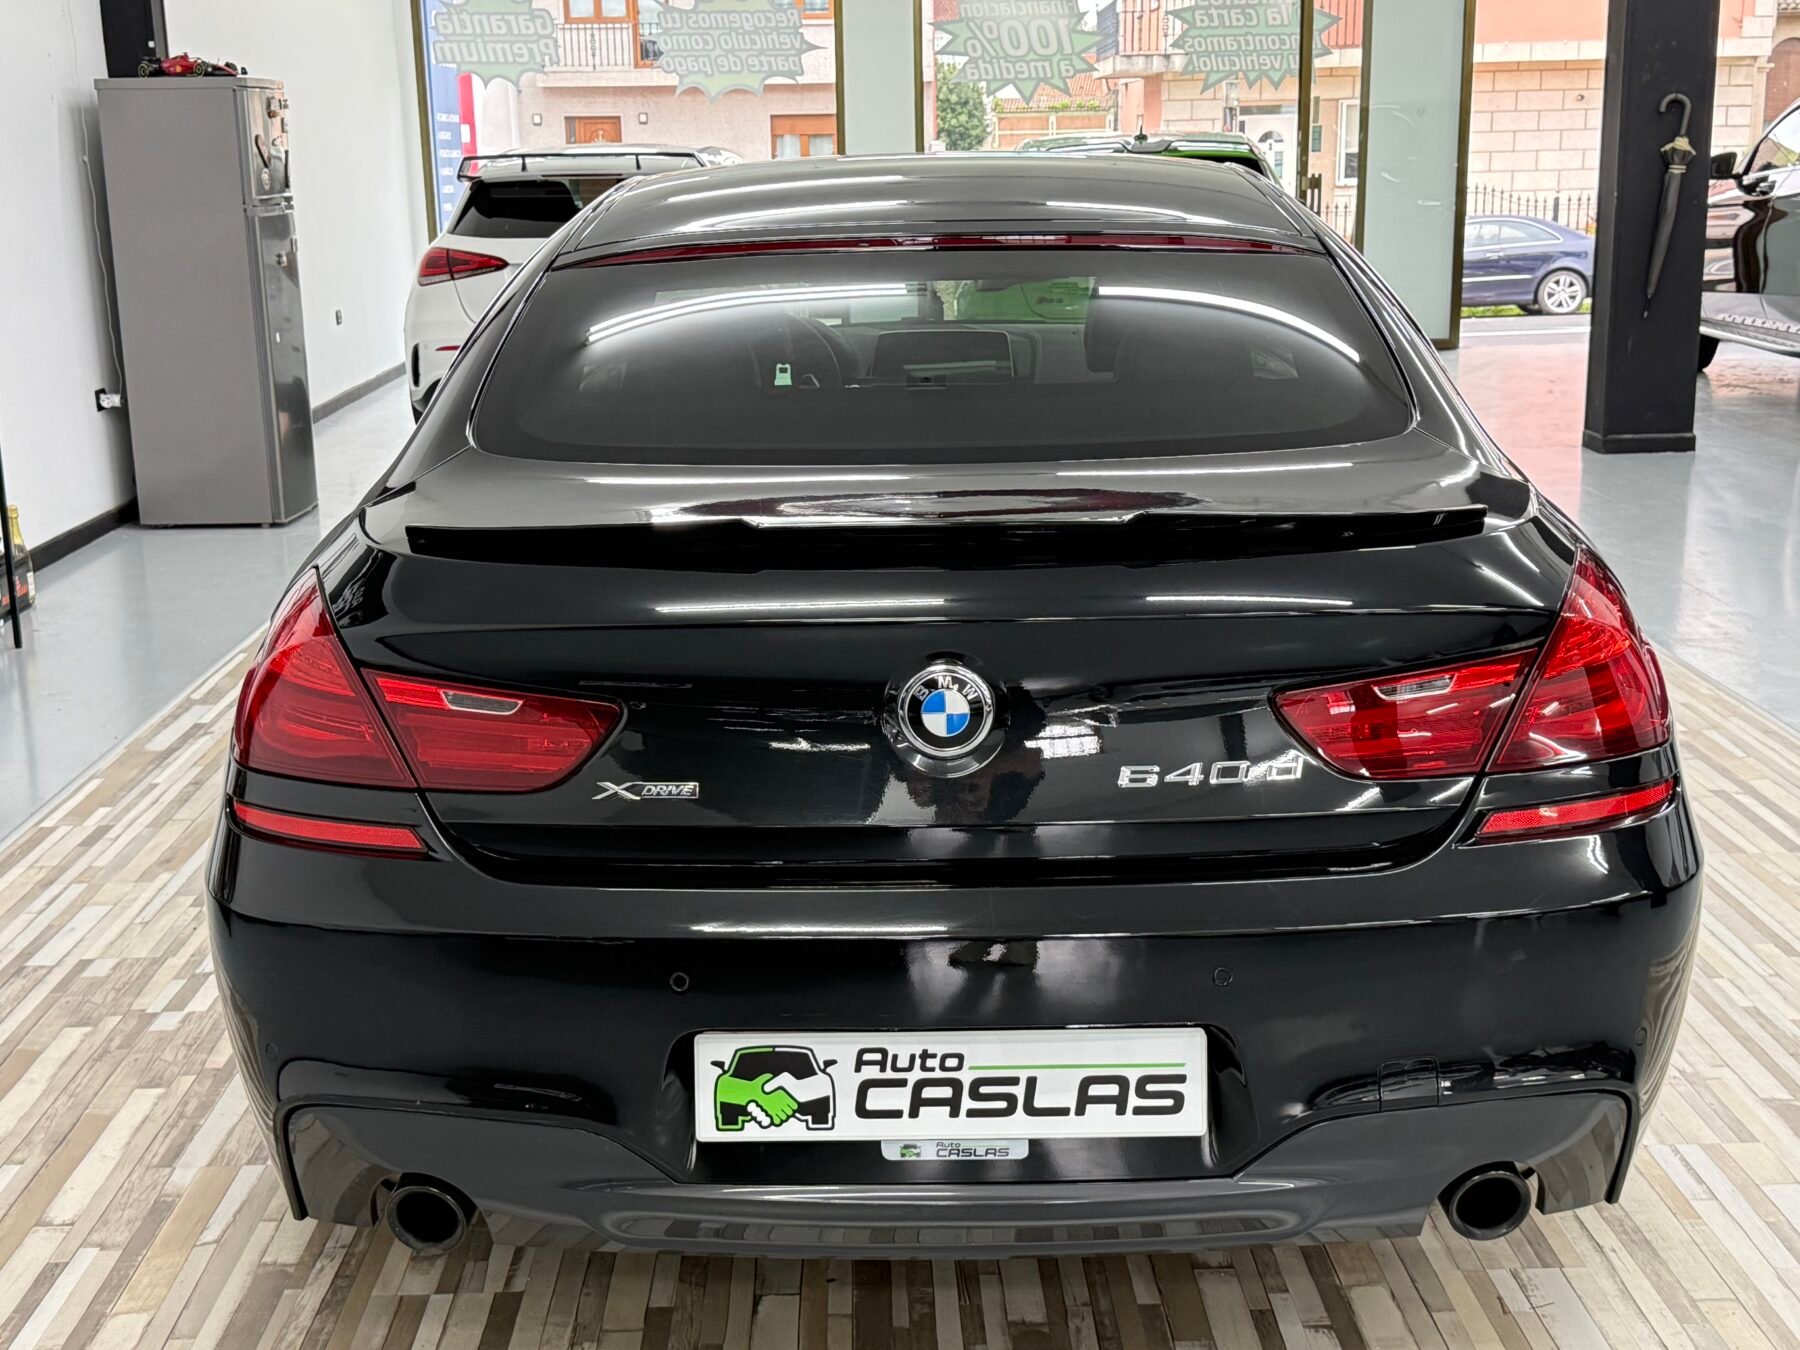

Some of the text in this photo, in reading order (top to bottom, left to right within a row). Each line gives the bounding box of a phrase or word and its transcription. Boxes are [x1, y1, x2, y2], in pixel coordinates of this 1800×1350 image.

[913, 675, 979, 702] BMW
[854, 1047, 965, 1073] Auto
[855, 1074, 1187, 1119] CASLAS
[935, 1147, 1010, 1158] CASLAS
